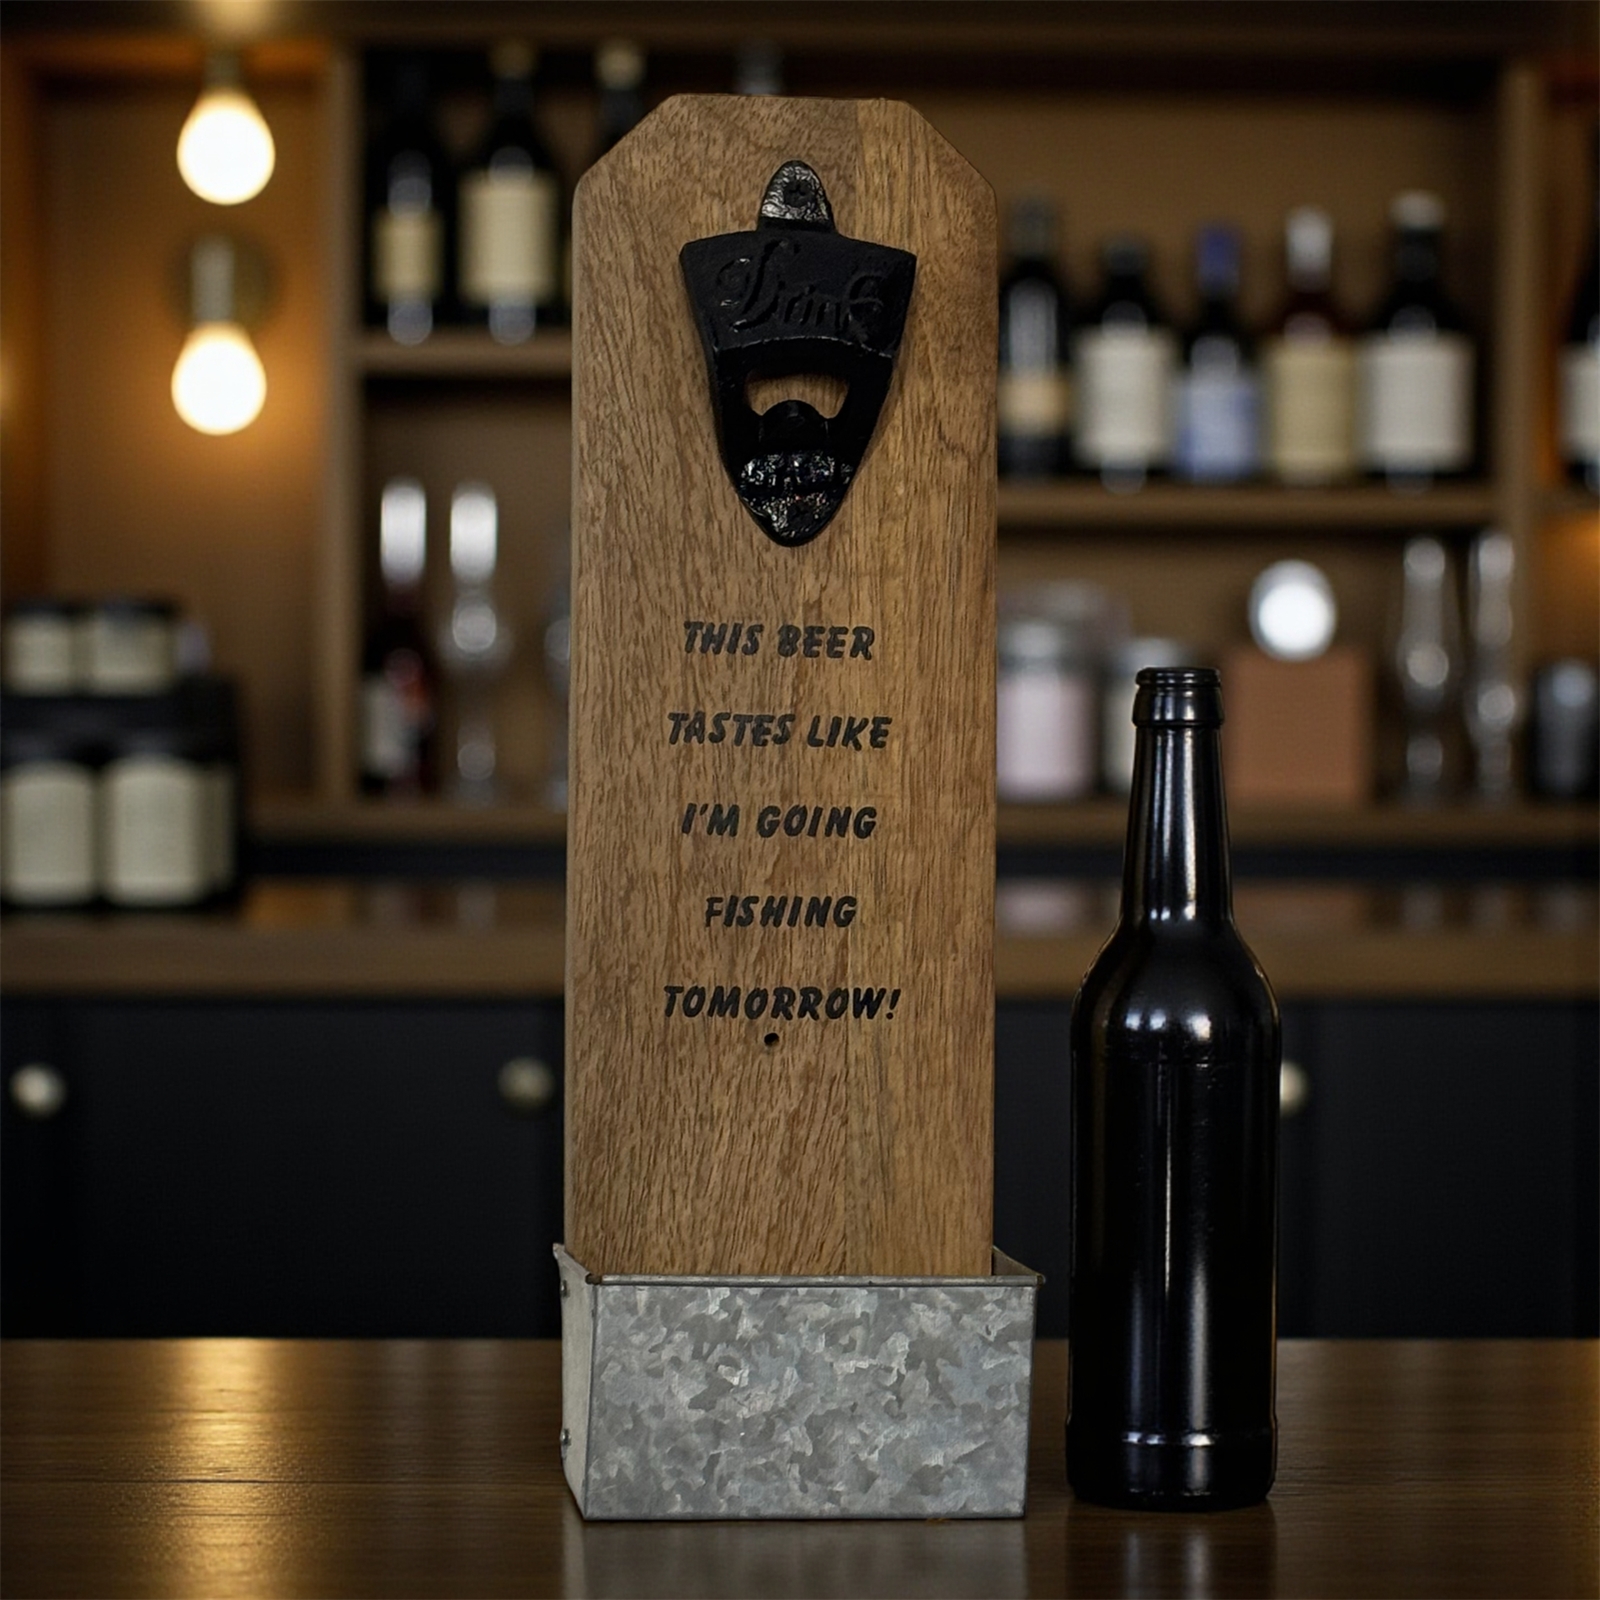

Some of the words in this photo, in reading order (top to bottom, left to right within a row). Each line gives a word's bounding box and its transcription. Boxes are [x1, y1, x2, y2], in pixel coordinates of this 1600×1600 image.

[683, 621, 764, 655] THIS
[777, 623, 875, 661] BEER
[667, 711, 796, 747] TASTES
[806, 715, 893, 751] LIKE
[681, 803, 740, 838] I'M
[756, 804, 877, 839] GOING
[705, 895, 858, 928] FISHING
[663, 985, 901, 1021] TOMORROW!
